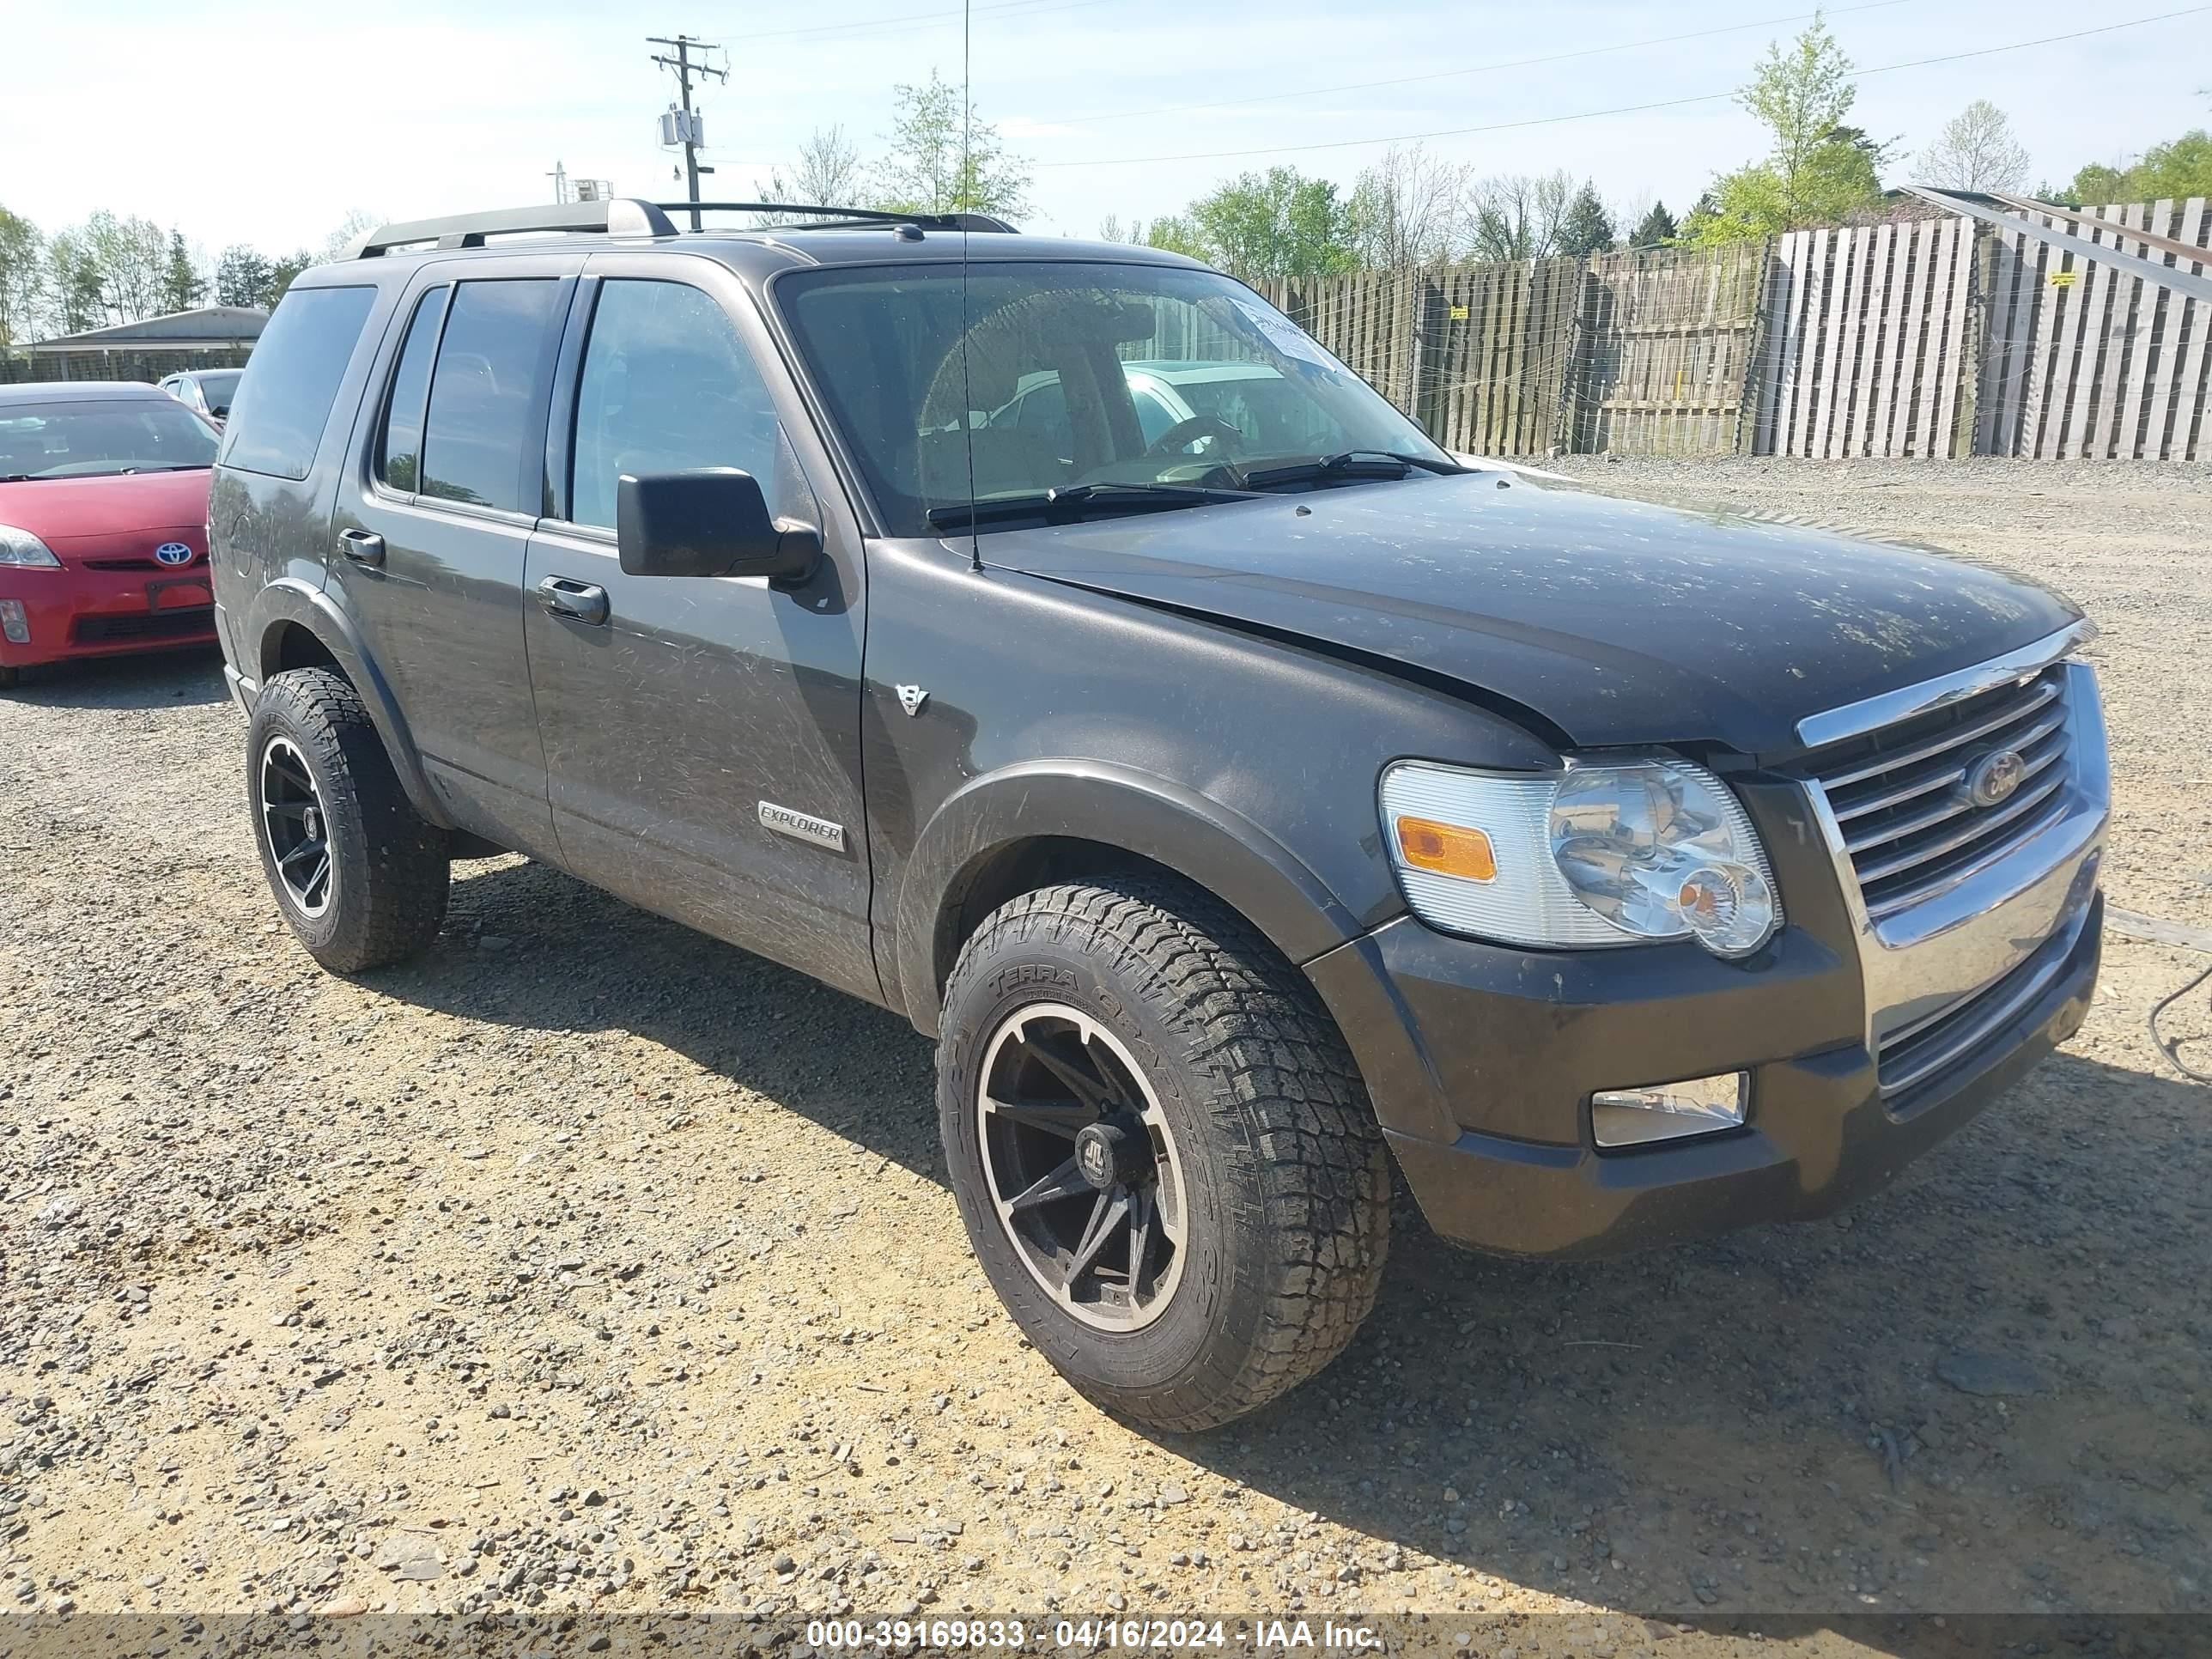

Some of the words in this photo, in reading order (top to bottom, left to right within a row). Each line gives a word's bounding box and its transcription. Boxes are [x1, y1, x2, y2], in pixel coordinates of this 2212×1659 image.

[1989, 757, 2018, 796] Ford
[761, 805, 841, 842] EXPLORER
[988, 963, 1079, 998] TERRA
